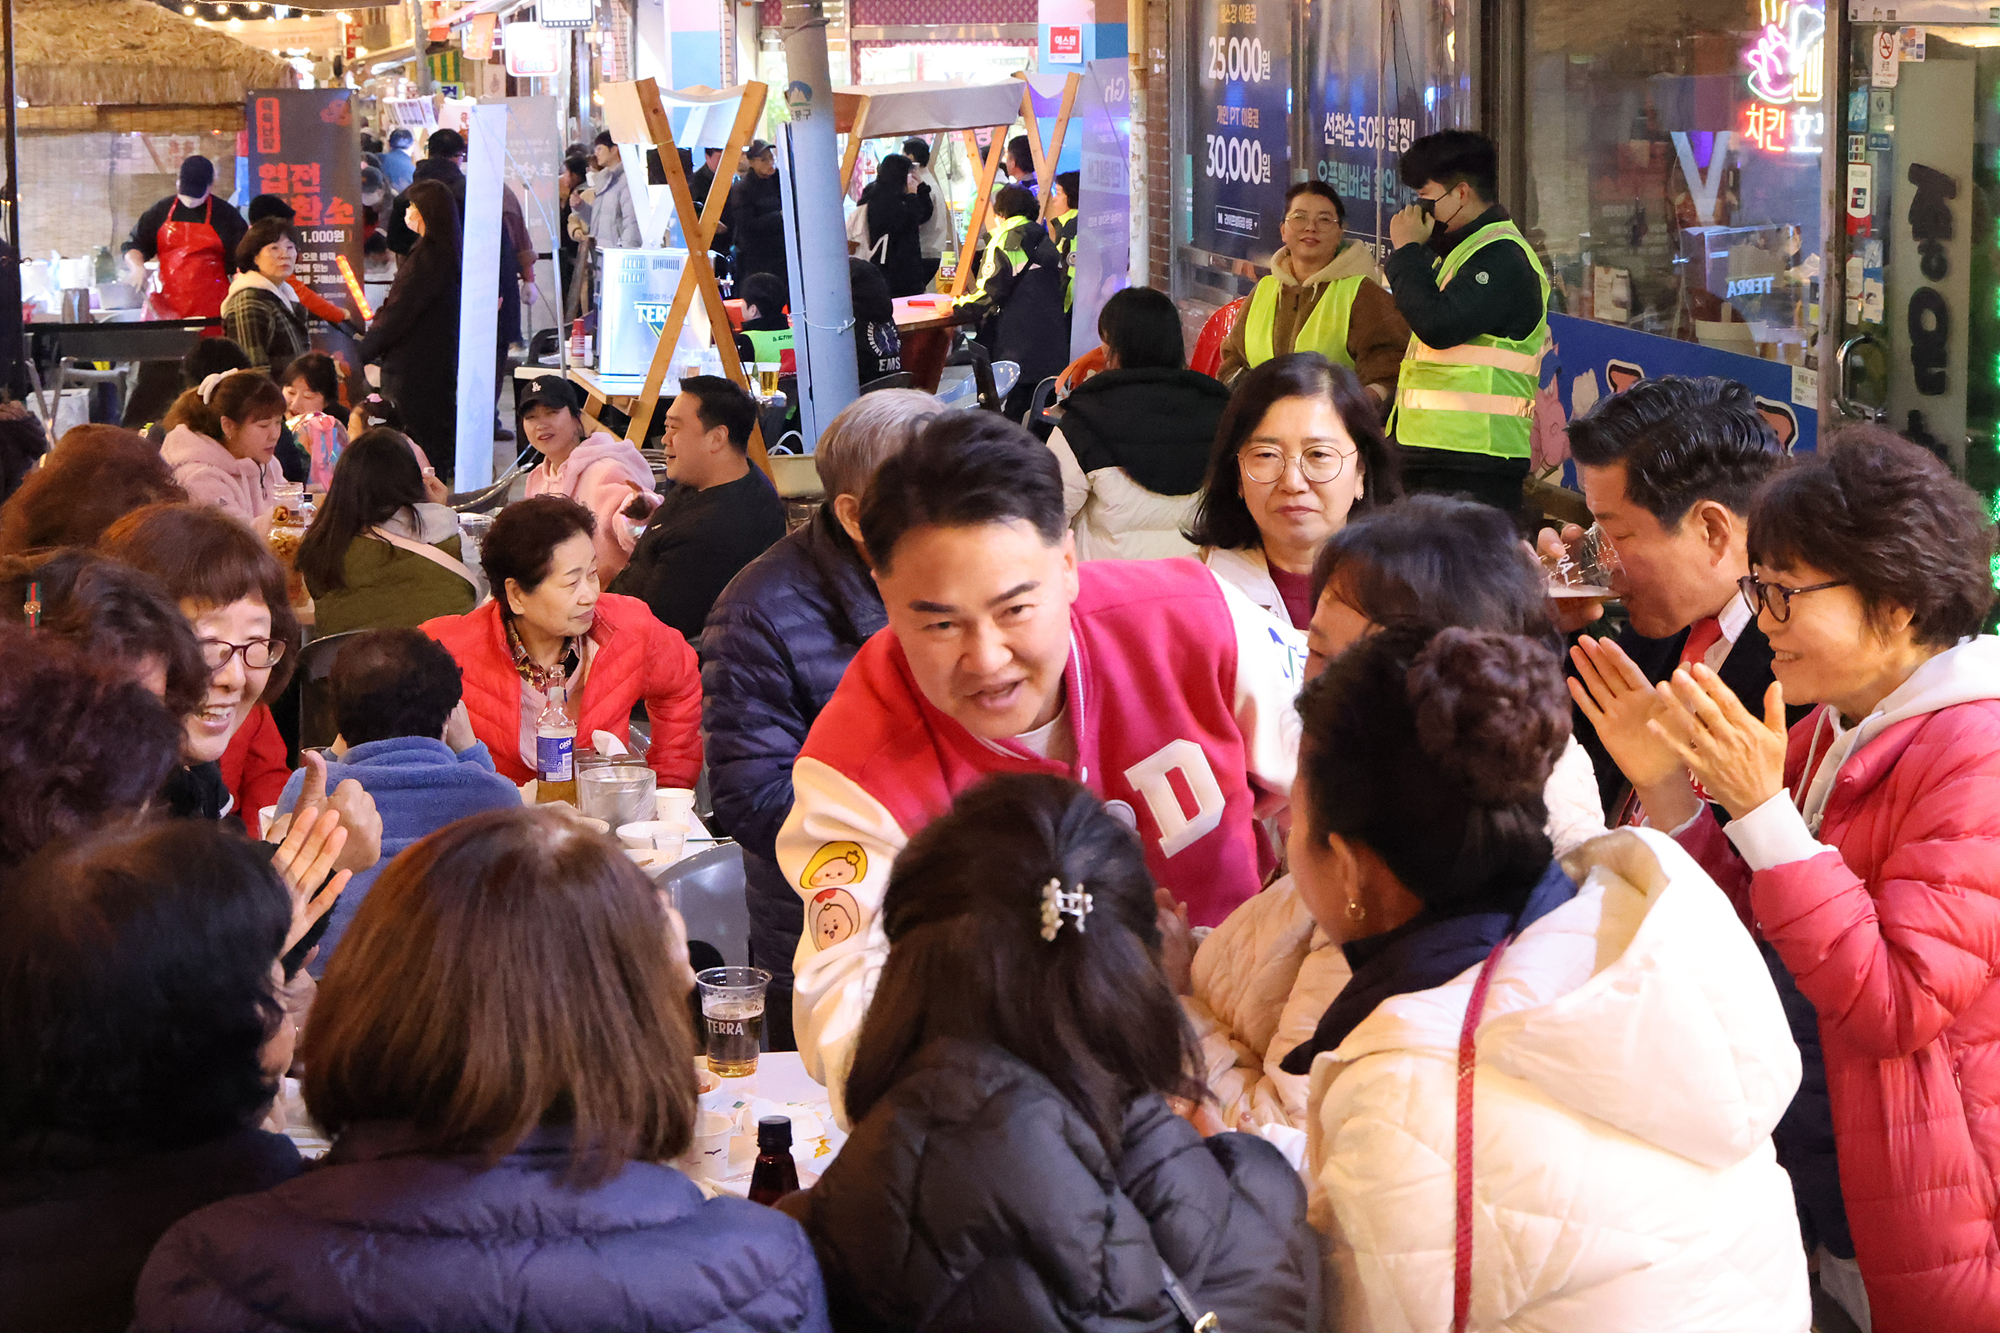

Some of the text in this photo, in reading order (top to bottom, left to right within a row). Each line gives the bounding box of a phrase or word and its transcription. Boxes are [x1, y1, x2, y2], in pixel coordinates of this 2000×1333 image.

[1239, 3, 1257, 24] 이용권
[1208, 36, 1270, 85] 25,000원
[1230, 106, 1241, 126] PT
[1242, 107, 1259, 129] 이용권
[1323, 112, 1416, 154] 선착순 50명 한정!
[1206, 134, 1271, 185] 30,000원
[259, 162, 321, 195] 엽전
[291, 194, 355, 226] 환소
[878, 356, 901, 372] EMS
[1123, 738, 1226, 859] D
[706, 1018, 744, 1036] TERRA
